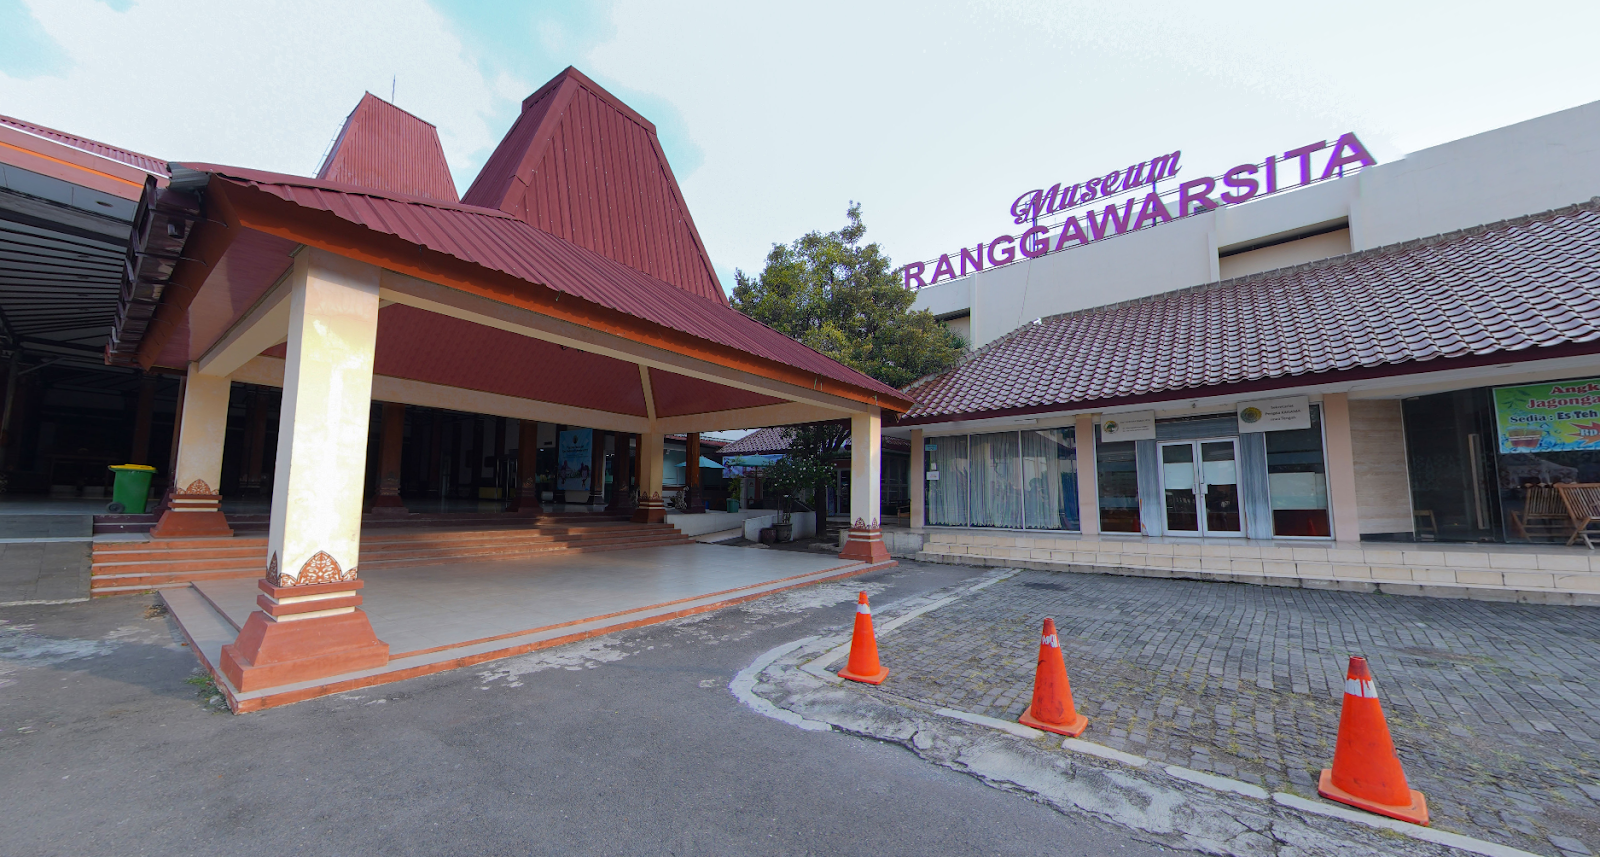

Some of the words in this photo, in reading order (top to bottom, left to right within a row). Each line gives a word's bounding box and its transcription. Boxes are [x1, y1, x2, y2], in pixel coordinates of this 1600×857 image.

[904, 131, 1377, 290] RANGGAWARSITA
[1010, 149, 1182, 225] Museum
[1510, 414, 1547, 423] Sedia
[1556, 411, 1571, 420] Es
[1574, 410, 1598, 419] Teh
